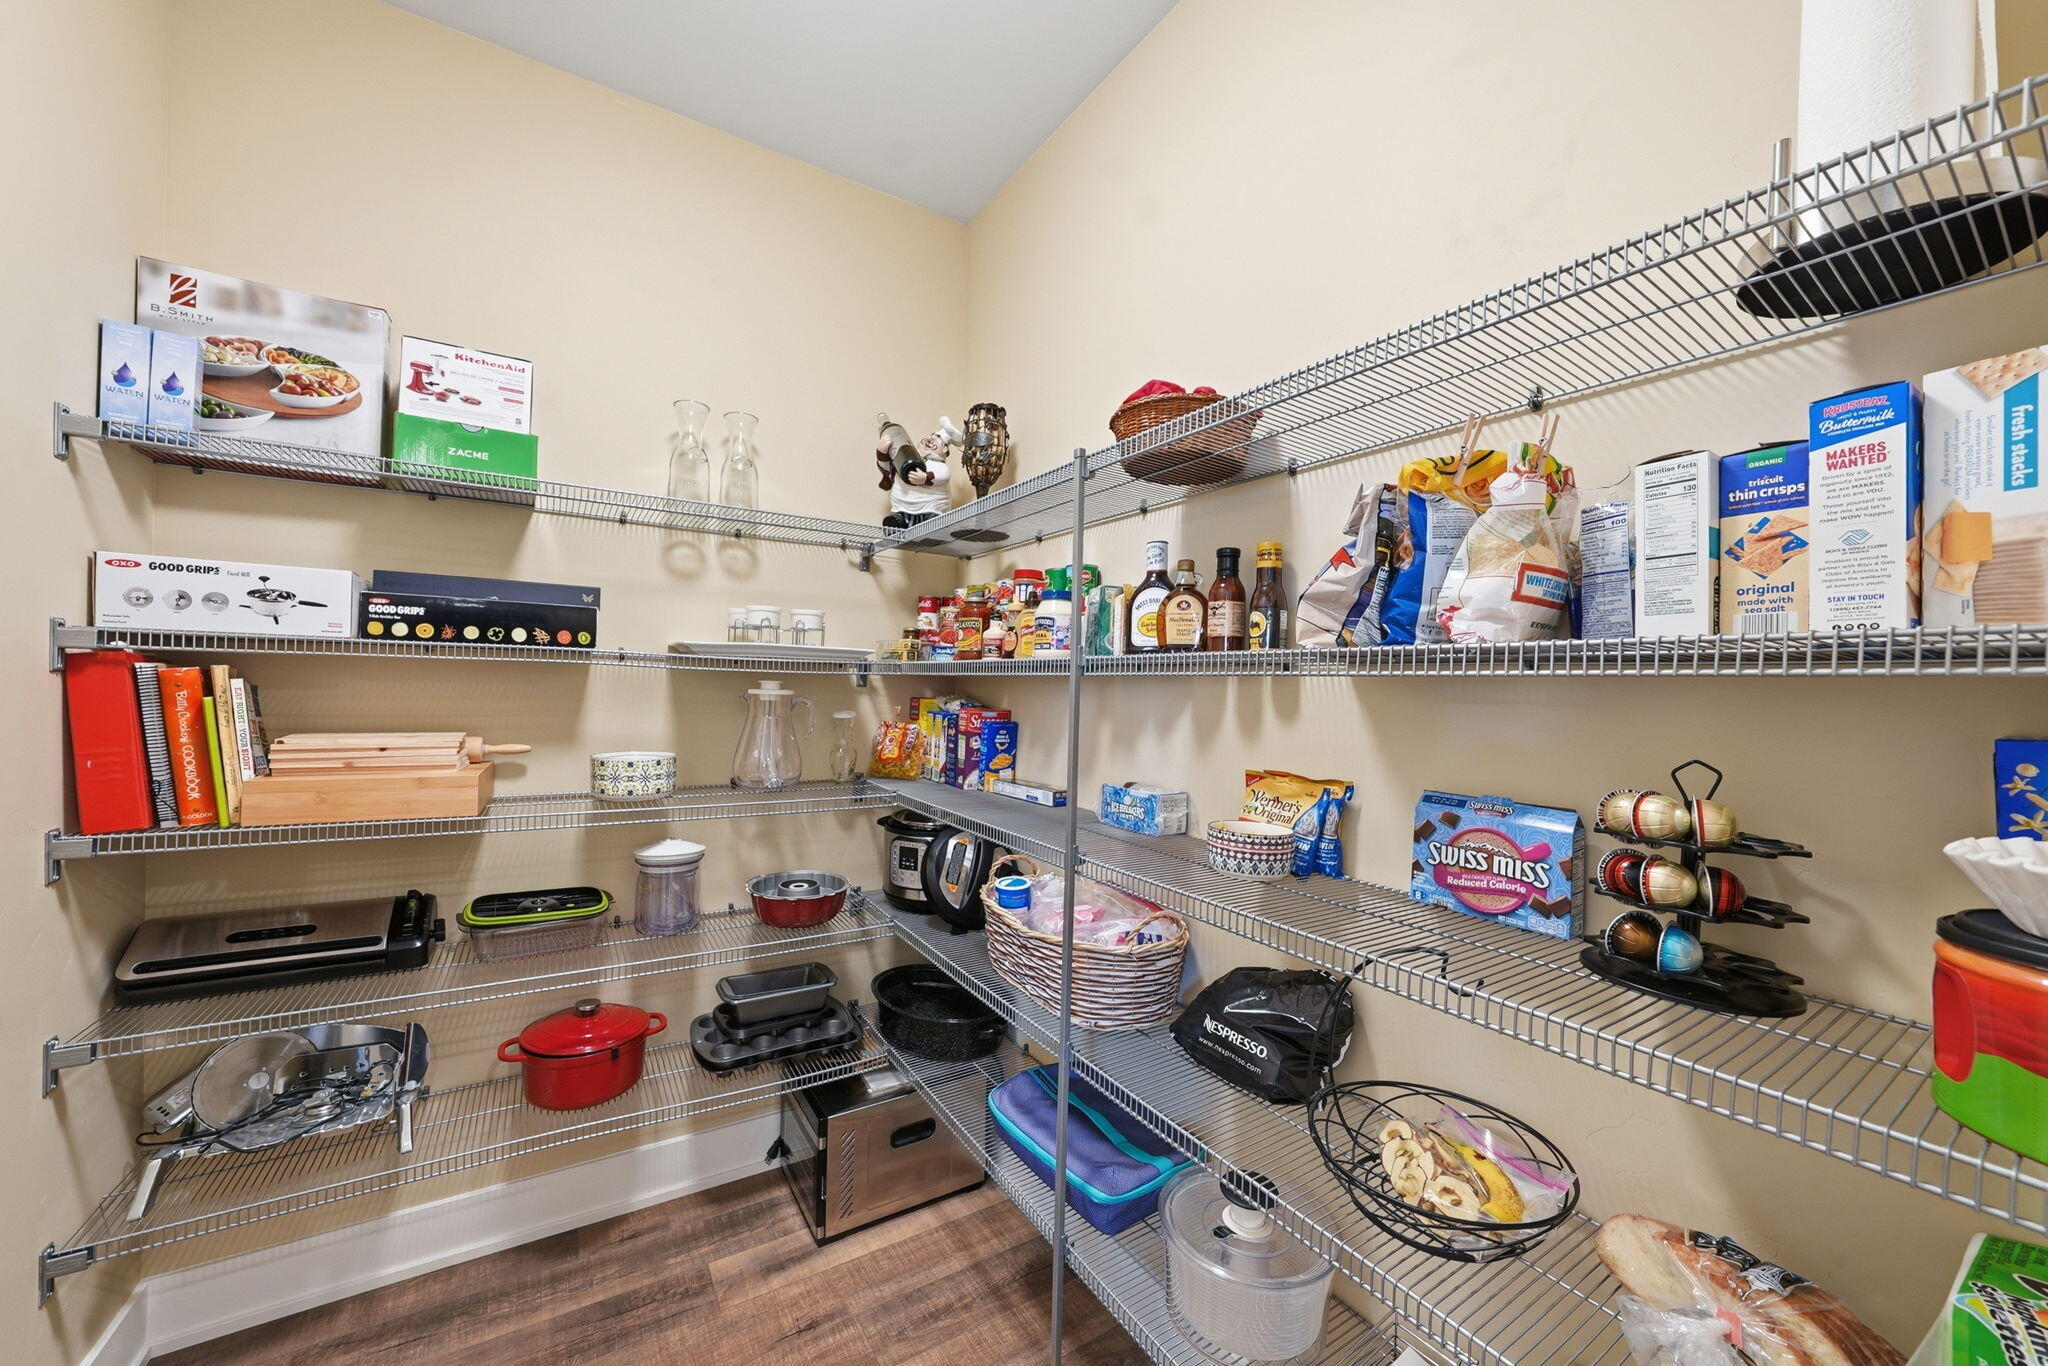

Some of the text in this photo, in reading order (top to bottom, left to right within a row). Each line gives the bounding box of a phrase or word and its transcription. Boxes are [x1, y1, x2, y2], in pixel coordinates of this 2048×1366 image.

[454, 353, 526, 374] KitchenAid
[1824, 396, 1888, 418] KRUSTEAZ
[1819, 408, 1895, 434] Buttermilk
[448, 446, 489, 460] ZACME
[1826, 441, 1886, 461] MAKERS
[2011, 404, 2034, 487] fresh stacks
[1644, 462, 1696, 476] Nutrition Facts
[1748, 458, 1783, 468] ORGANIC
[1826, 452, 1887, 472] WANTED
[1964, 444, 1975, 477] PREMIUM
[1748, 475, 1784, 486] triscuit
[1728, 482, 1806, 502] thin crisps
[1611, 518, 1626, 526] 100
[148, 561, 220, 575] GOOD GRIPS
[1526, 574, 1552, 589] WHITE
[1736, 582, 1795, 597] original
[368, 604, 426, 615] GOOD GRIPS
[1738, 596, 1793, 606] made with
[1765, 604, 1786, 613] salt
[234, 687, 251, 771] EAT RIGHT YOUR SIGHT
[176, 689, 188, 711] Betty
[182, 745, 202, 800] COOKBOOK
[1250, 789, 1302, 814] Werther's
[1469, 801, 1493, 810] SWISS
[1494, 804, 1515, 815] MISS
[1254, 805, 1295, 824] Original
[1426, 841, 1552, 889] SWISS MISS
[1447, 875, 1527, 894] Reduced Calorie
[1415, 891, 1421, 899] 8
[1203, 1014, 1268, 1060] NESPRESSO
[1198, 1036, 1262, 1075] www.nespresso.com
